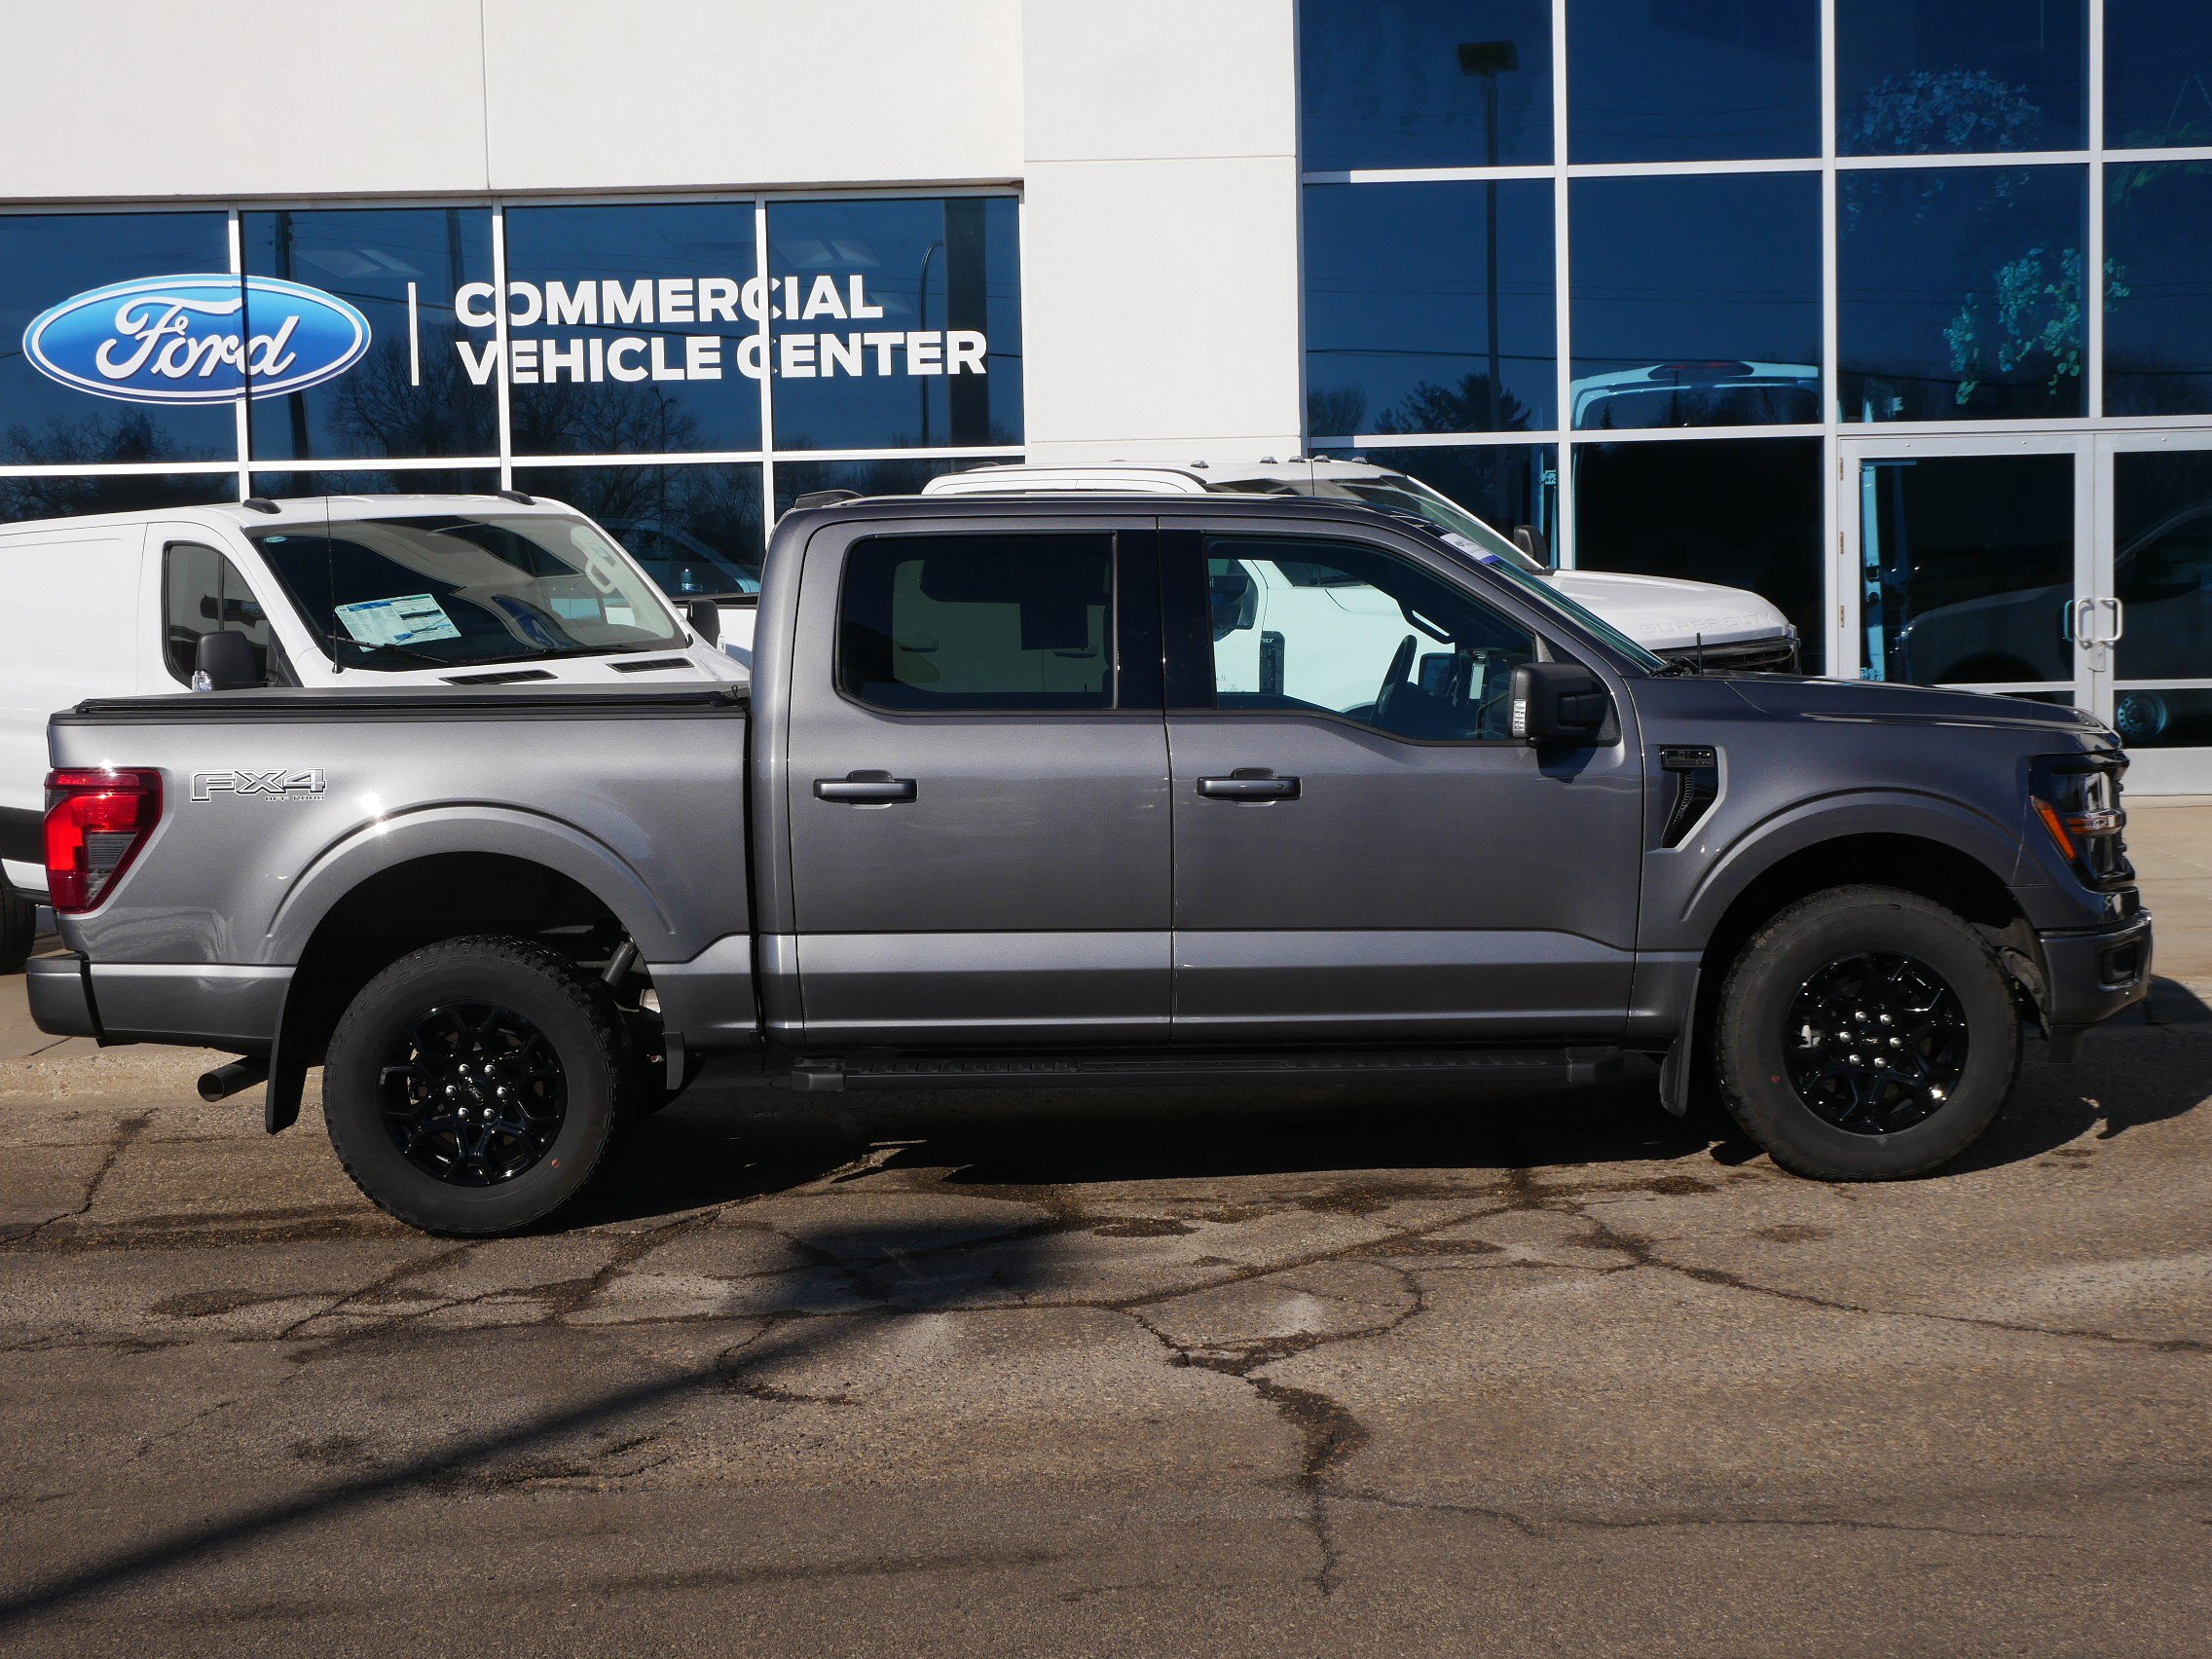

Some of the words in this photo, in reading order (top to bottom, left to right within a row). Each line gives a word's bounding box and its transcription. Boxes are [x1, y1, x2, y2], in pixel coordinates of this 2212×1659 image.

[454, 275, 884, 328] COMMERCIAL
[94, 296, 301, 380] Ford
[455, 335, 722, 386] VEHICLE
[735, 329, 988, 380] CENTER
[190, 768, 327, 803] FX4
